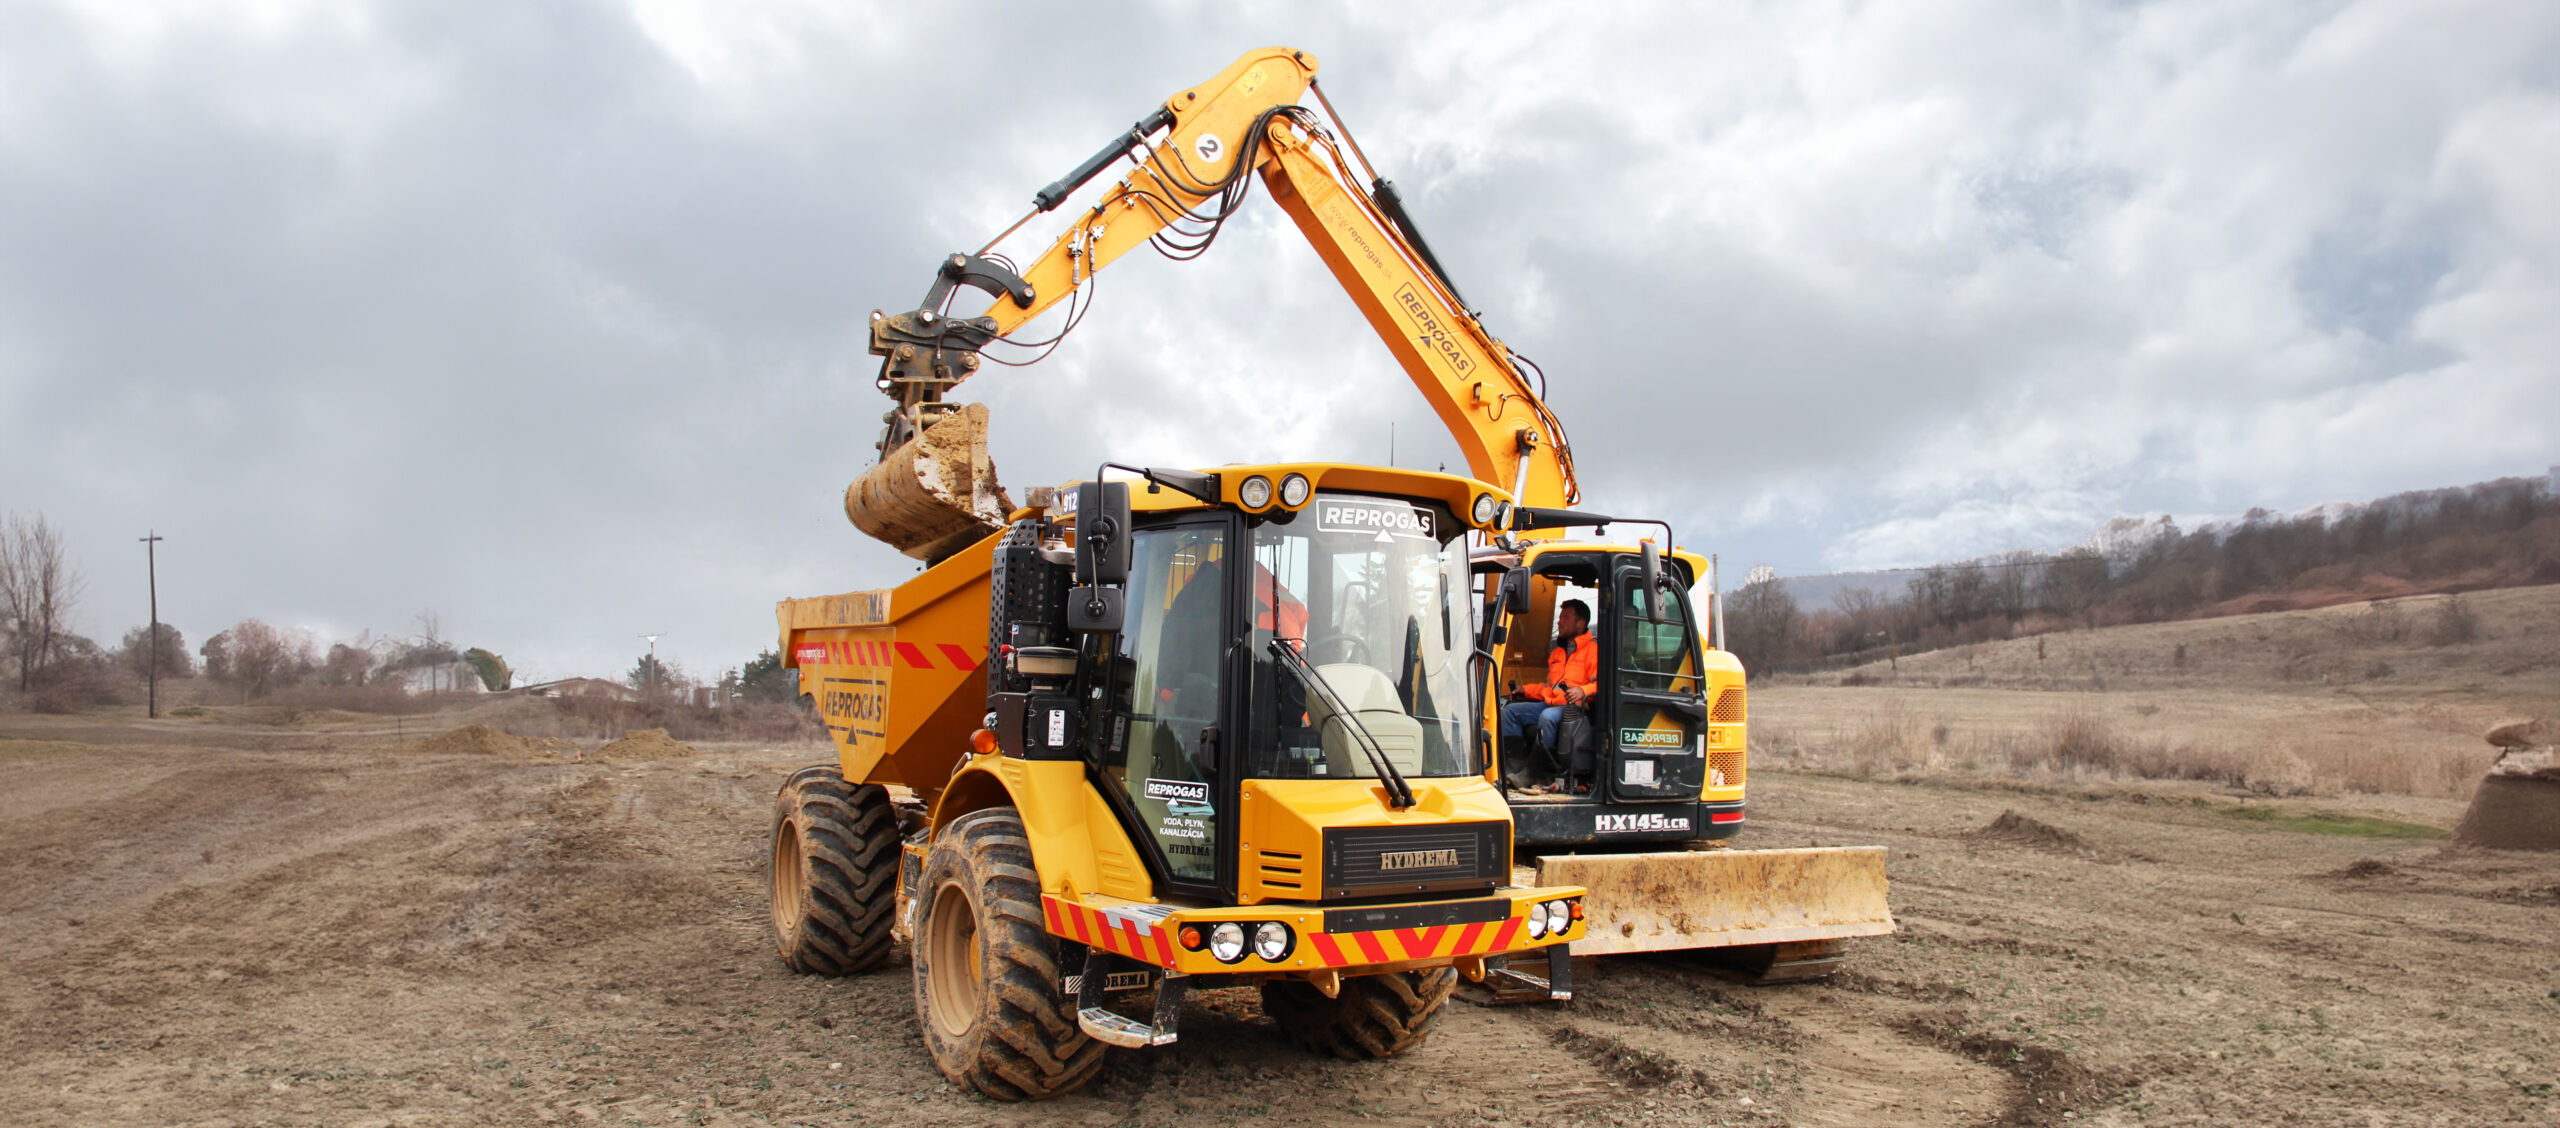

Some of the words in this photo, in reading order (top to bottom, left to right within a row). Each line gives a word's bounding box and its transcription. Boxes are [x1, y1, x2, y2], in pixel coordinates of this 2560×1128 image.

[1199, 139, 1218, 158] 2
[1401, 292, 1469, 371] REPROGAS
[1063, 492, 1078, 513] 912
[1325, 506, 1431, 533] REPROGAS
[825, 691, 882, 722] REPROGAS
[1147, 783, 1204, 799] REPROGAS
[1163, 817, 1184, 828] VODA,
[1184, 818, 1205, 830] PLYN,
[1595, 813, 1690, 832] HX145LCR
[1159, 827, 1205, 839] KANALIZÁCIA
[1168, 843, 1210, 857] HYDREMA
[1380, 848, 1459, 871] HYDREMA
